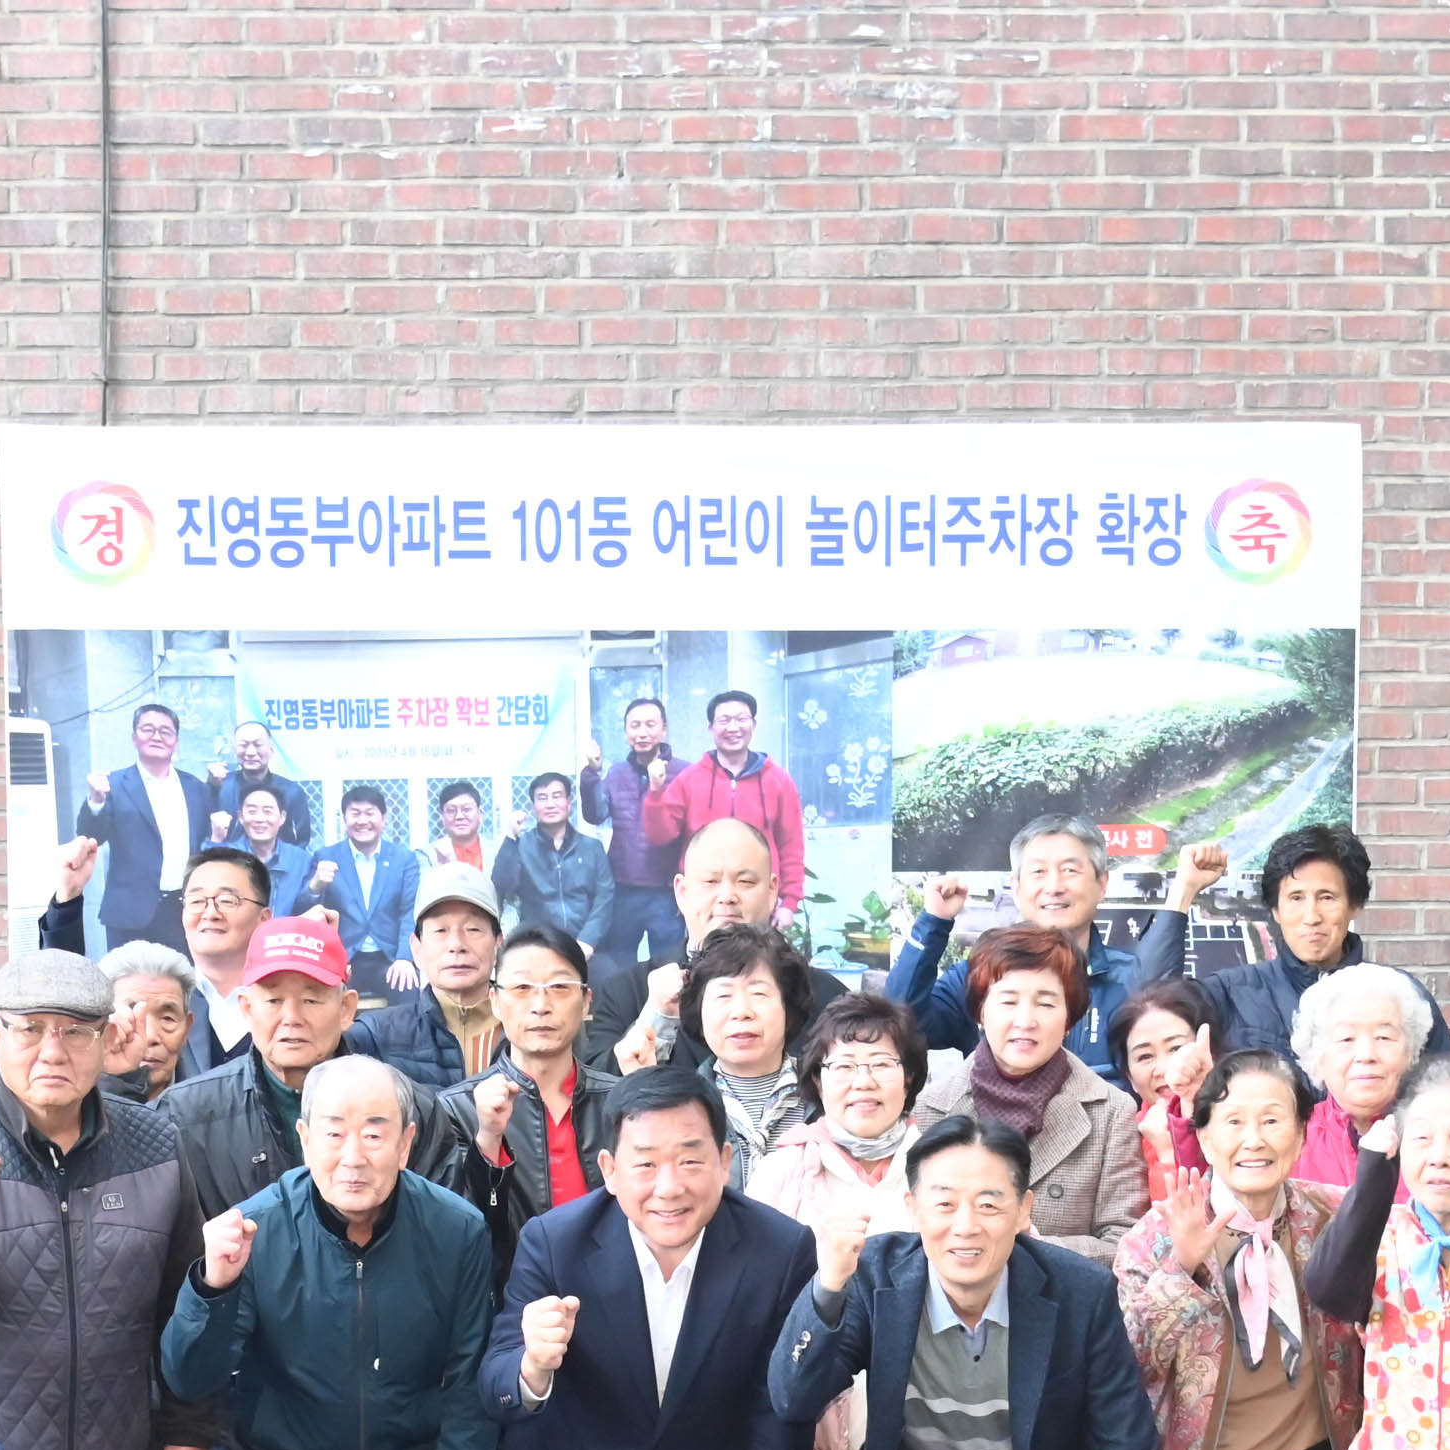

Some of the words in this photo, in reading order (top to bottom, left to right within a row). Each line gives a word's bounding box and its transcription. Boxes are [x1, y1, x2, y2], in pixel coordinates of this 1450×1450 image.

[79, 506, 125, 567] 경
[177, 495, 492, 569] 진영동부아파트
[512, 496, 632, 569] 101동
[653, 495, 784, 567] 어린이
[805, 493, 1079, 568] 놀이터주차장
[1096, 492, 1188, 567] 확장
[1228, 504, 1287, 565] 축
[264, 698, 390, 730] 진영동부아파트
[397, 697, 449, 728] 주차장
[456, 696, 491, 727] 확보
[496, 693, 549, 727] 간담회
